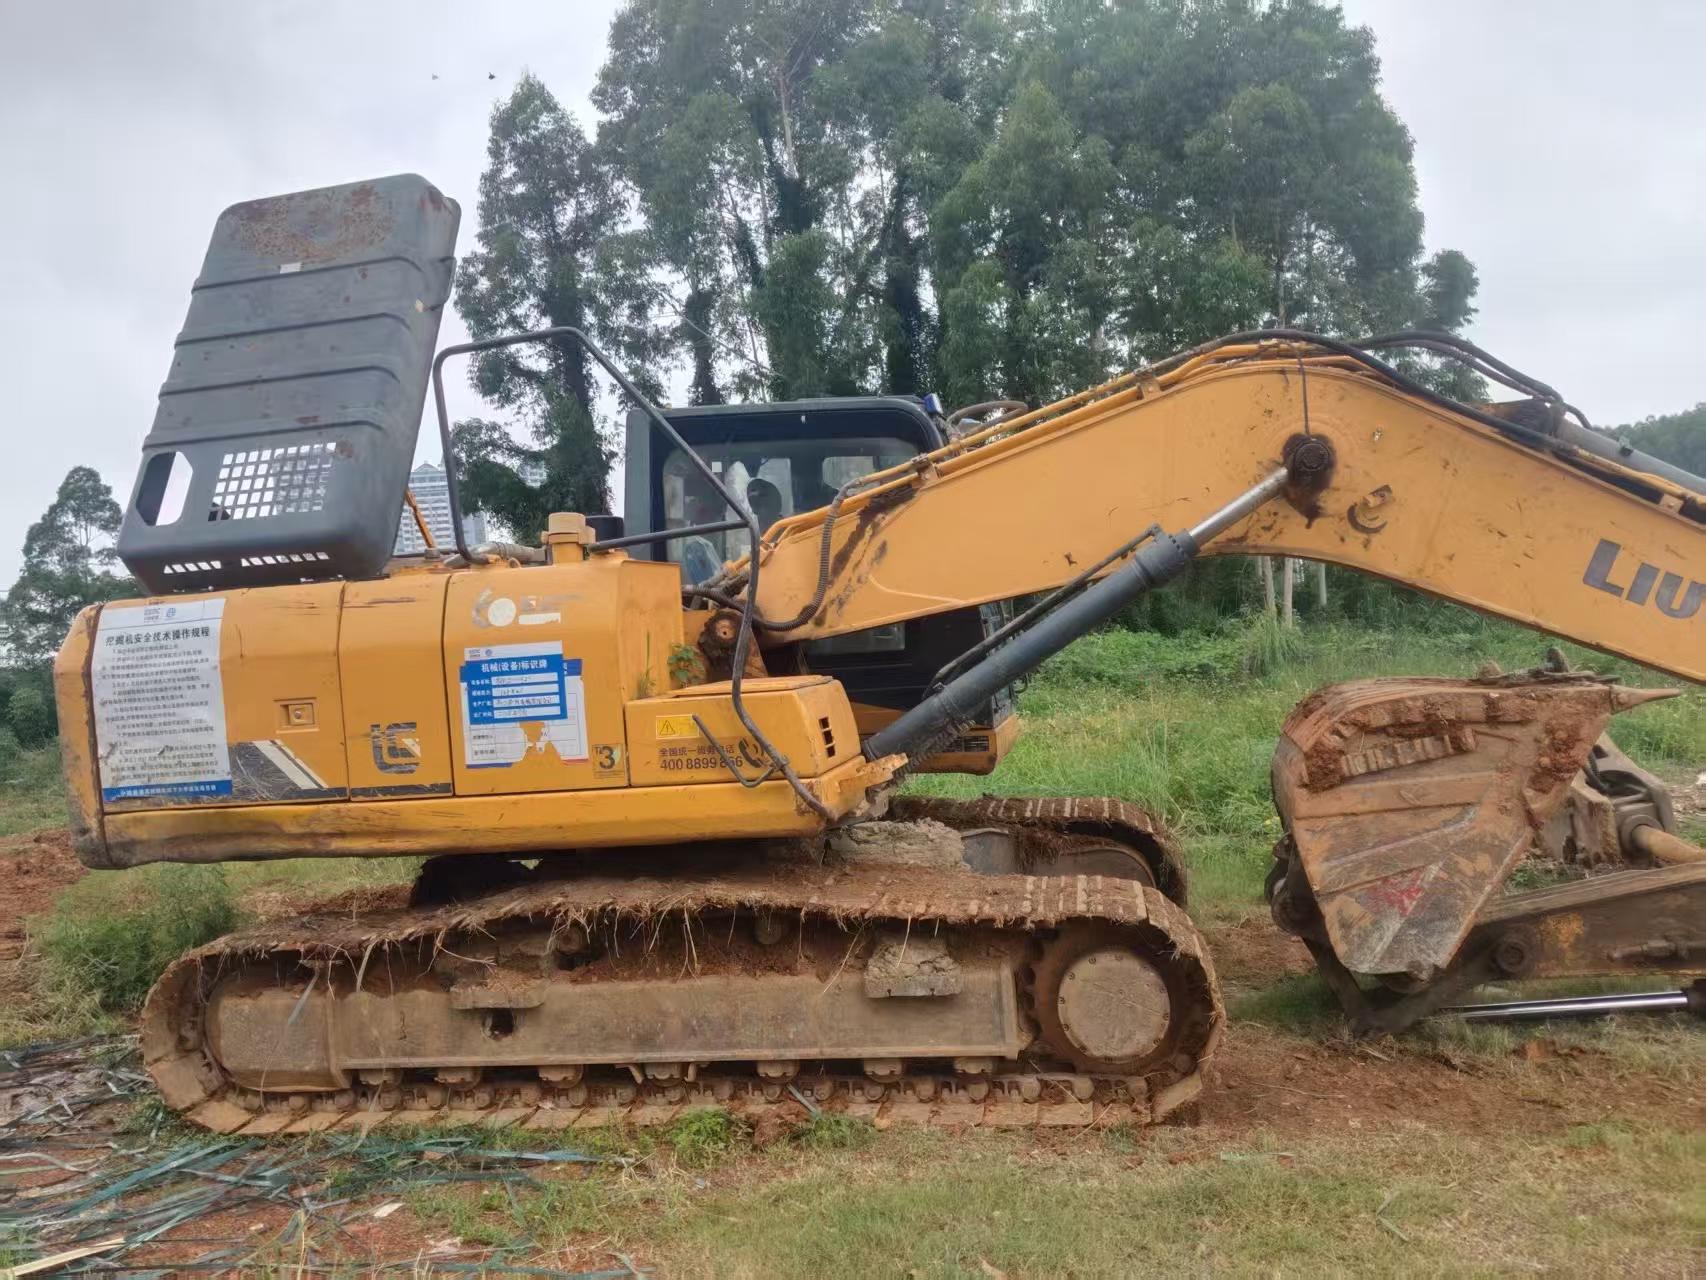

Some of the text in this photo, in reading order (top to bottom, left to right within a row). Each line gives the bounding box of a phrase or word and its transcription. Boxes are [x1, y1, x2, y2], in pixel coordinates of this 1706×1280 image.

[105, 626, 210, 647] 挖掘机安全技术操作规程
[660, 758, 684, 770] 400
[686, 756, 717, 769] 8899
